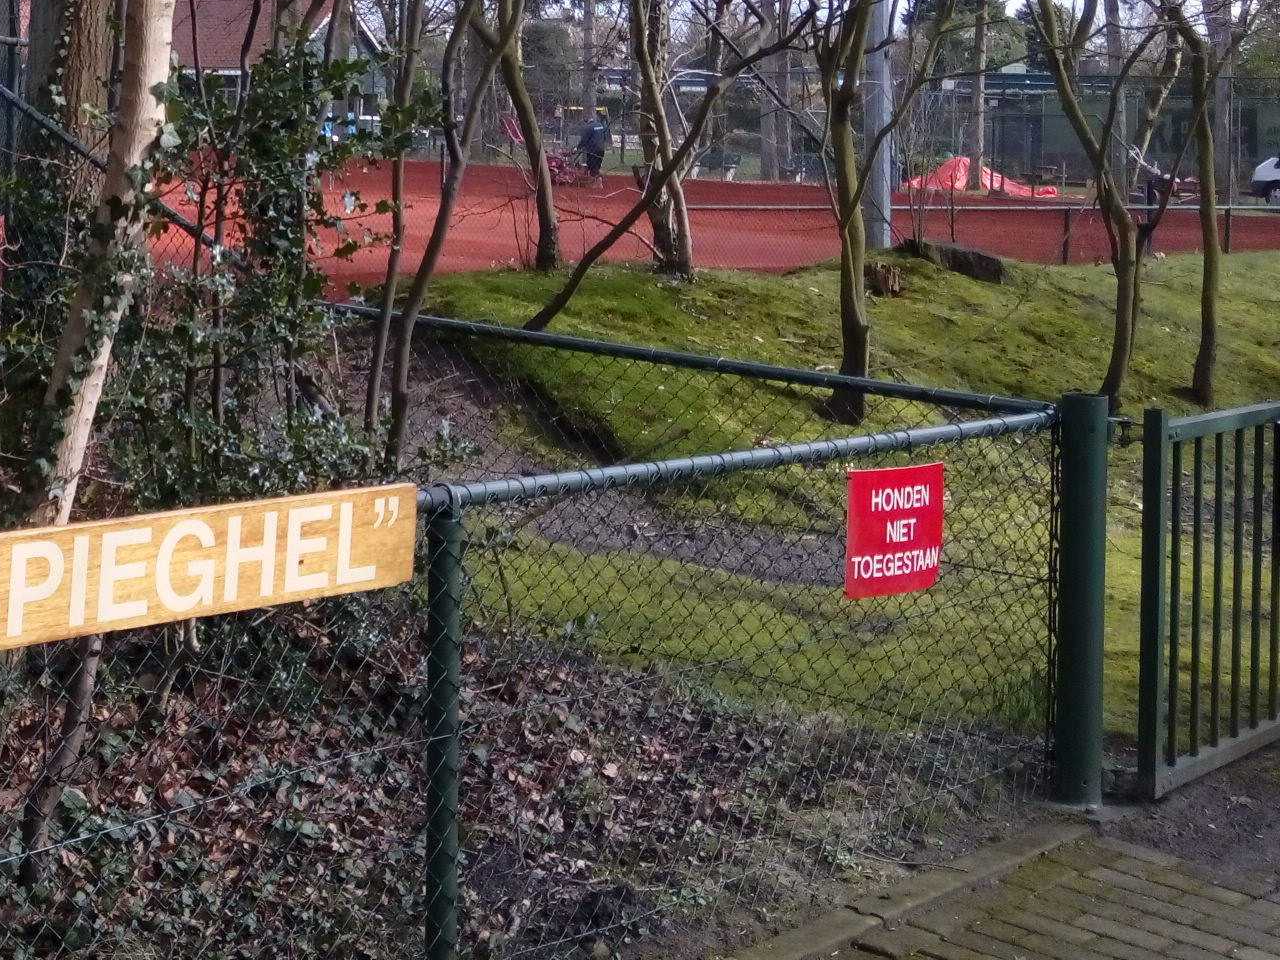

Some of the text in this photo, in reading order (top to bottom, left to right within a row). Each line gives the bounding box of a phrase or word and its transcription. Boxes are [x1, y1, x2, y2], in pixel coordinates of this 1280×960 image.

[871, 484, 930, 512] HONDEN
[886, 518, 917, 543] NIET
[851, 545, 939, 579] TOEGESTAAN
